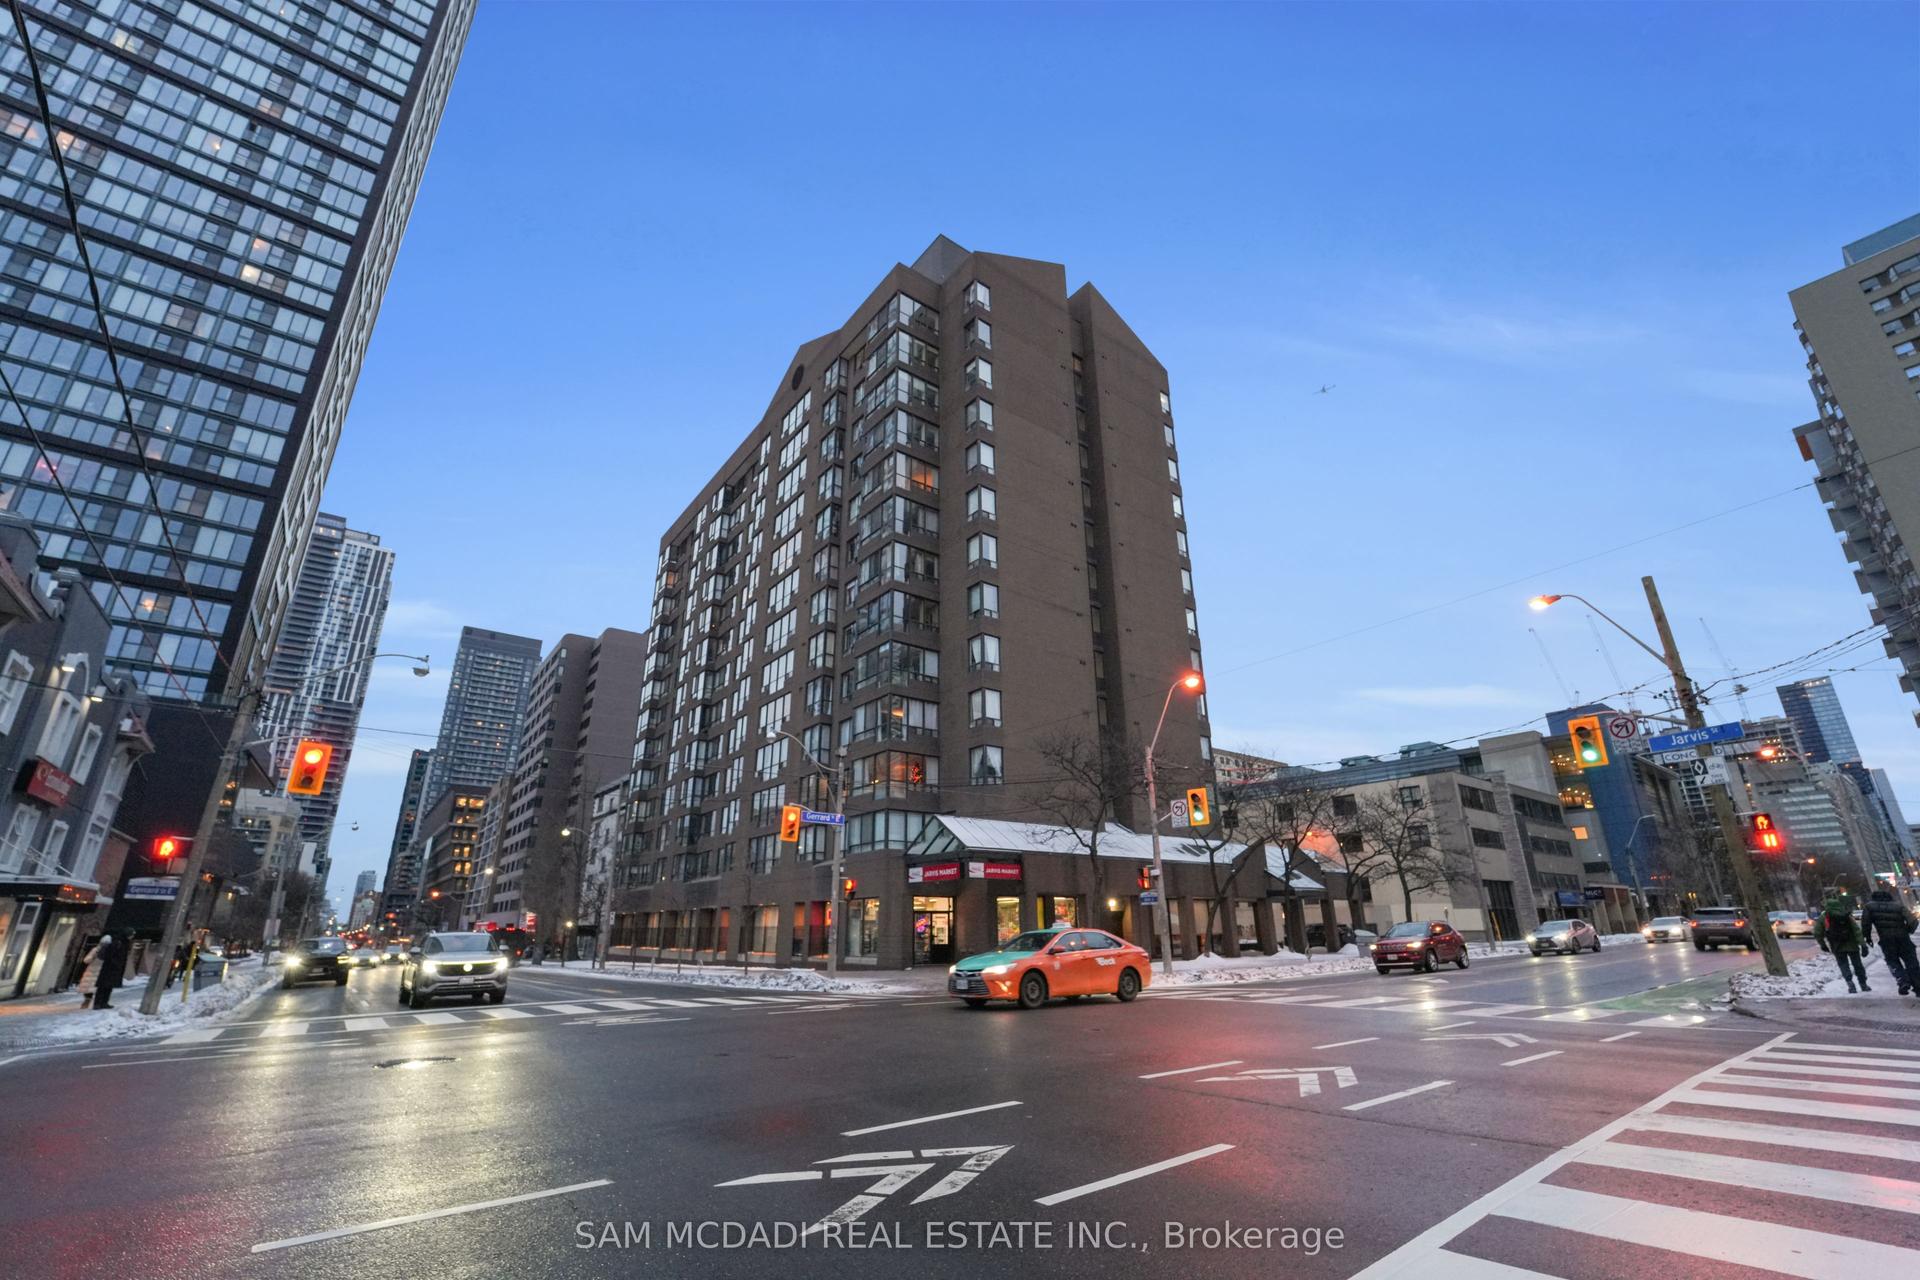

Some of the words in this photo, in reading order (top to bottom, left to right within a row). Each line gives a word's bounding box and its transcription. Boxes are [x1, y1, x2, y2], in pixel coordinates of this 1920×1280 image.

[1671, 729, 1709, 746] Jarvis
[1664, 747, 1723, 762] CONCD
[806, 812, 830, 822] Gerrard
[924, 869, 939, 877] JARVIS
[939, 867, 957, 876] MARKET
